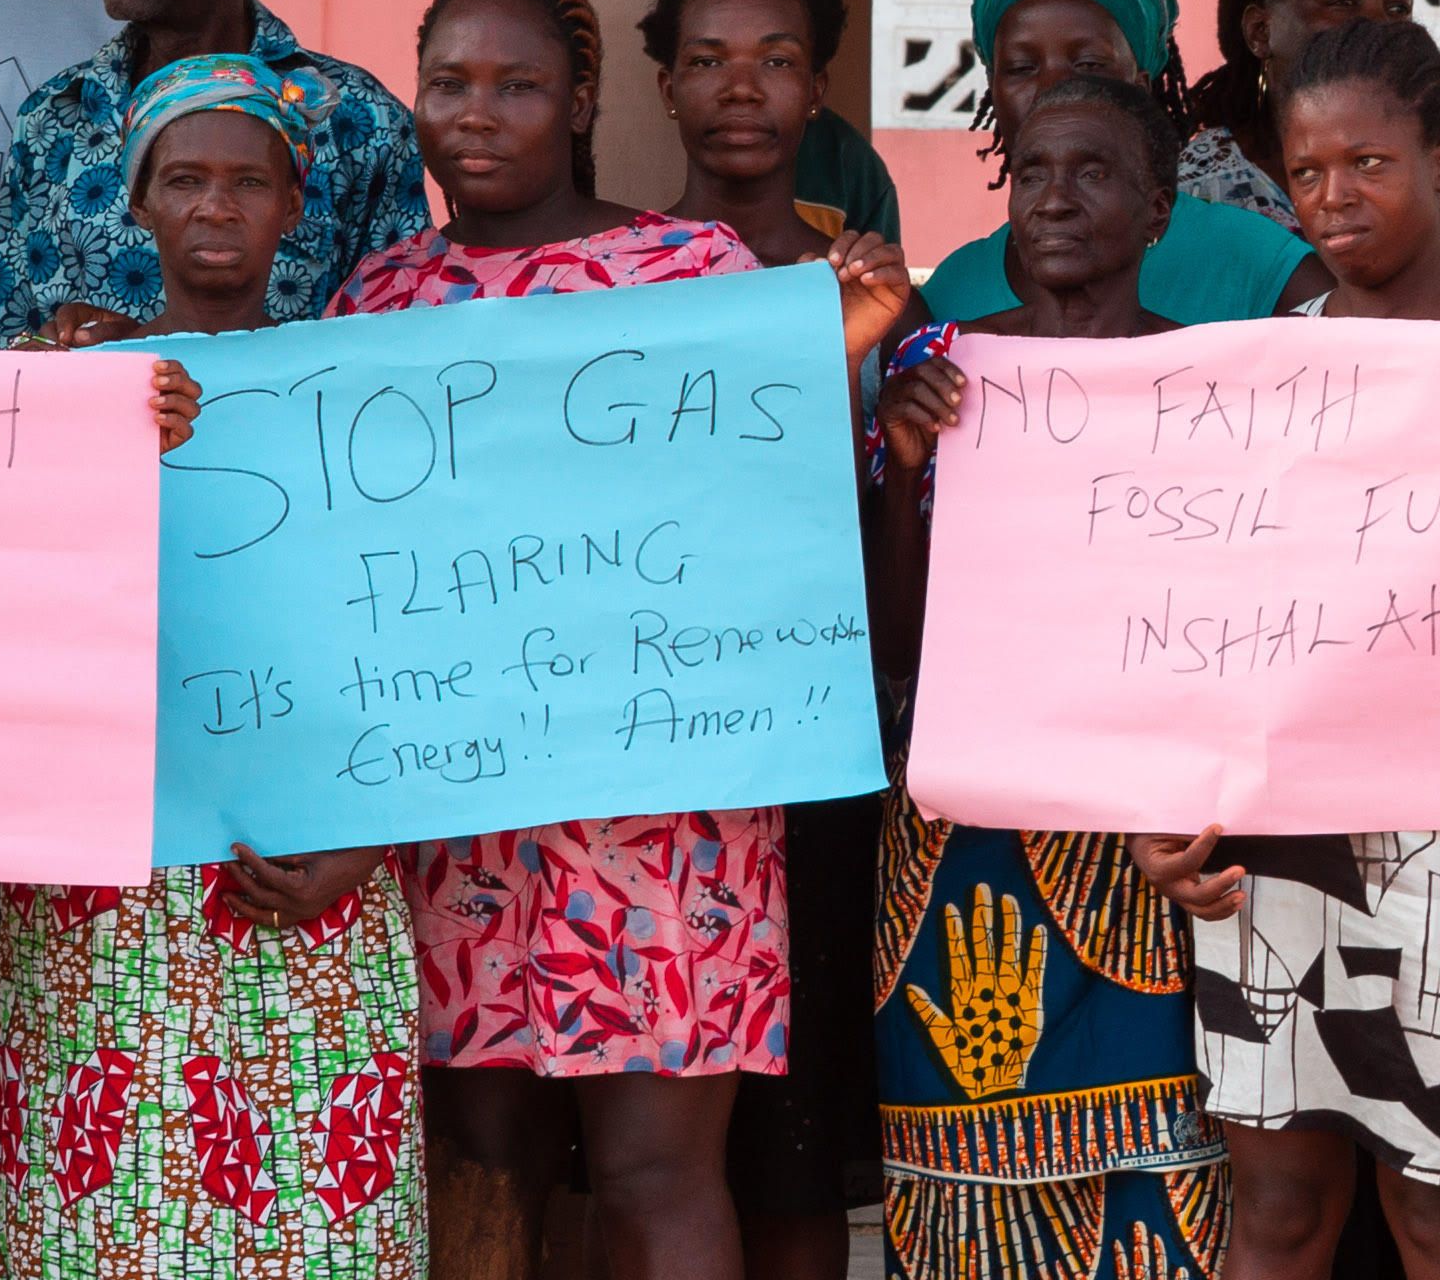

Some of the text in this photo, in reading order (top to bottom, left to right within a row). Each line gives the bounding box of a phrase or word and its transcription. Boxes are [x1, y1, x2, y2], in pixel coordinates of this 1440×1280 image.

[160, 349, 802, 560] STOP GAS
[976, 365, 1090, 450] NO
[1151, 363, 1361, 455] FAITH
[1088, 471, 1288, 546] FOSSIL
[347, 520, 705, 634] FLARING
[182, 667, 295, 735] It's
[341, 655, 479, 712] time
[502, 626, 598, 692] for
